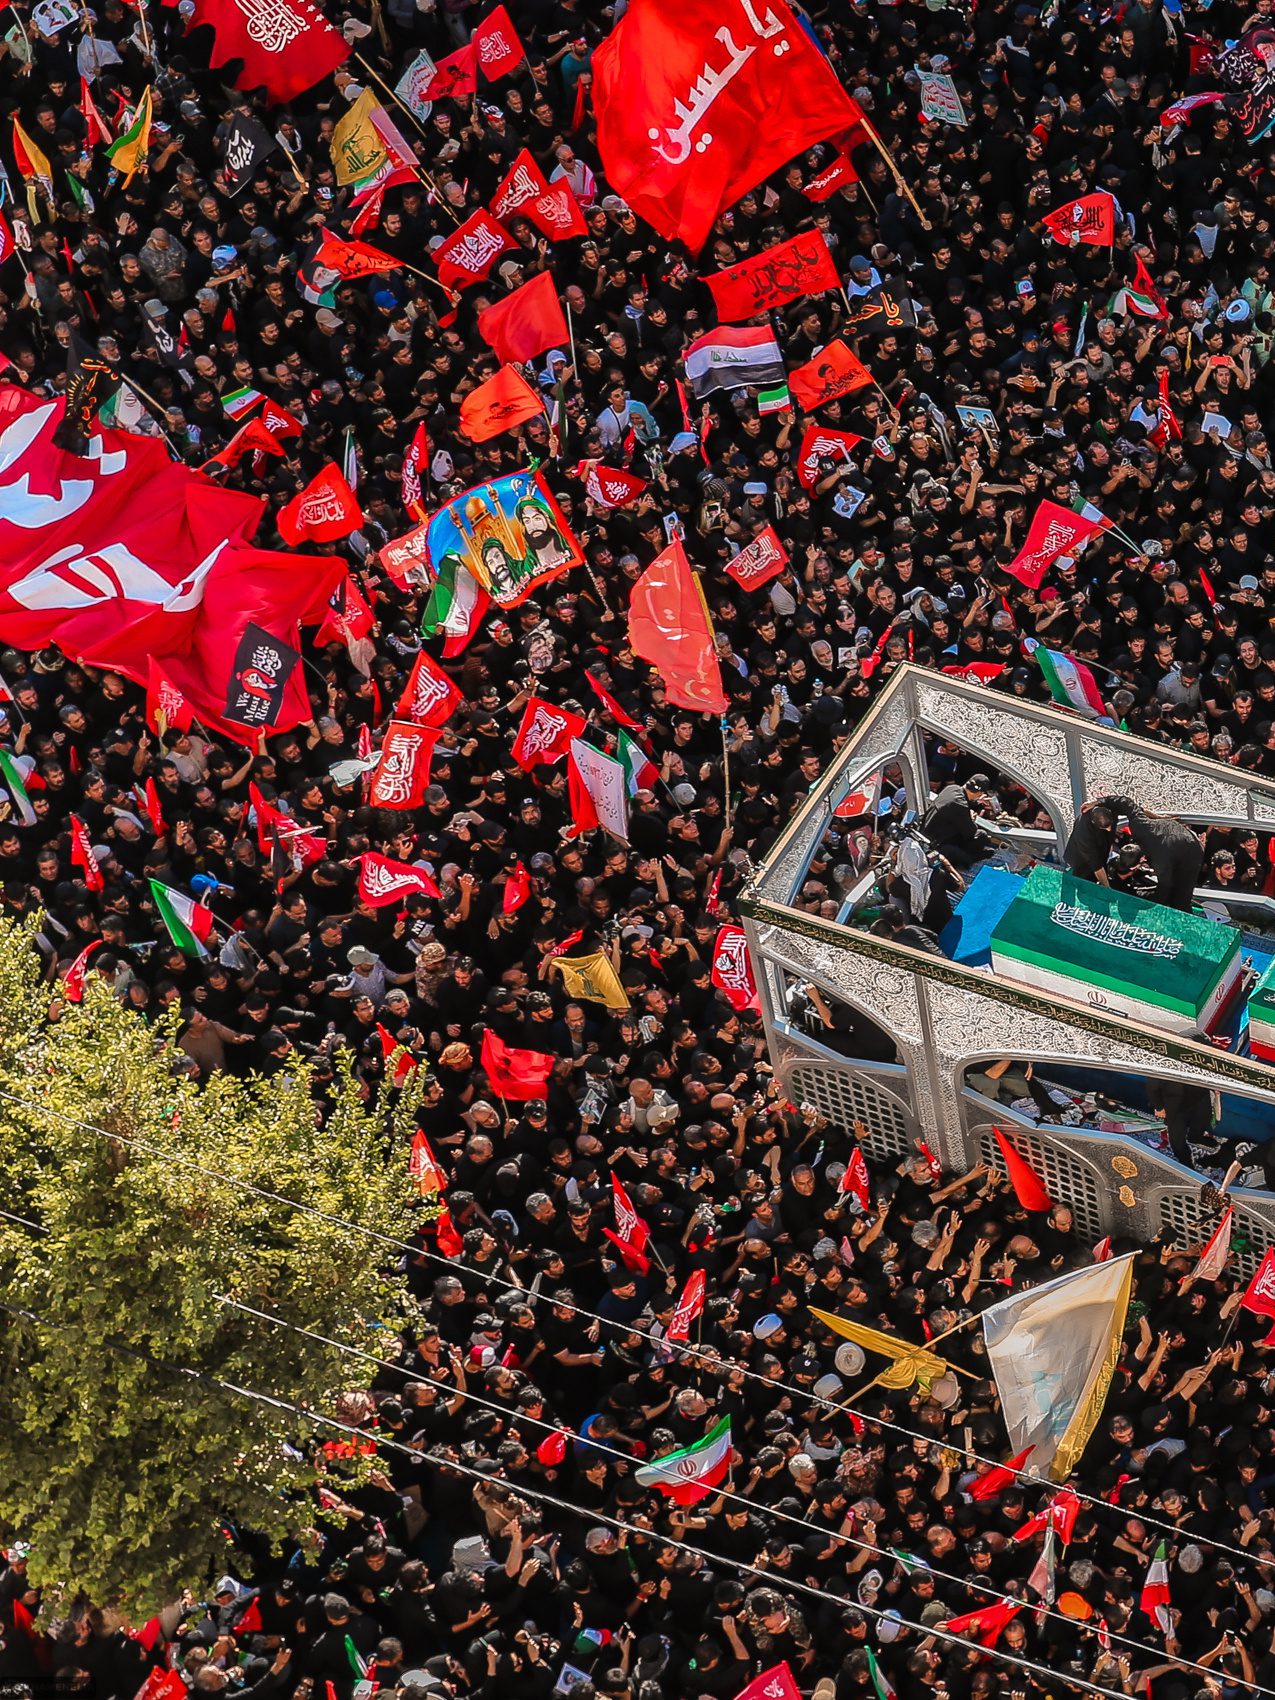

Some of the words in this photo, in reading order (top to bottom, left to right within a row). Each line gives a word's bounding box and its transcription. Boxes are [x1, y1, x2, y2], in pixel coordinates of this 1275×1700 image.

[843, 304, 883, 335] حسی
[236, 692, 251, 709] We
[243, 694, 261, 722] Must
[254, 699, 271, 722] Rise
